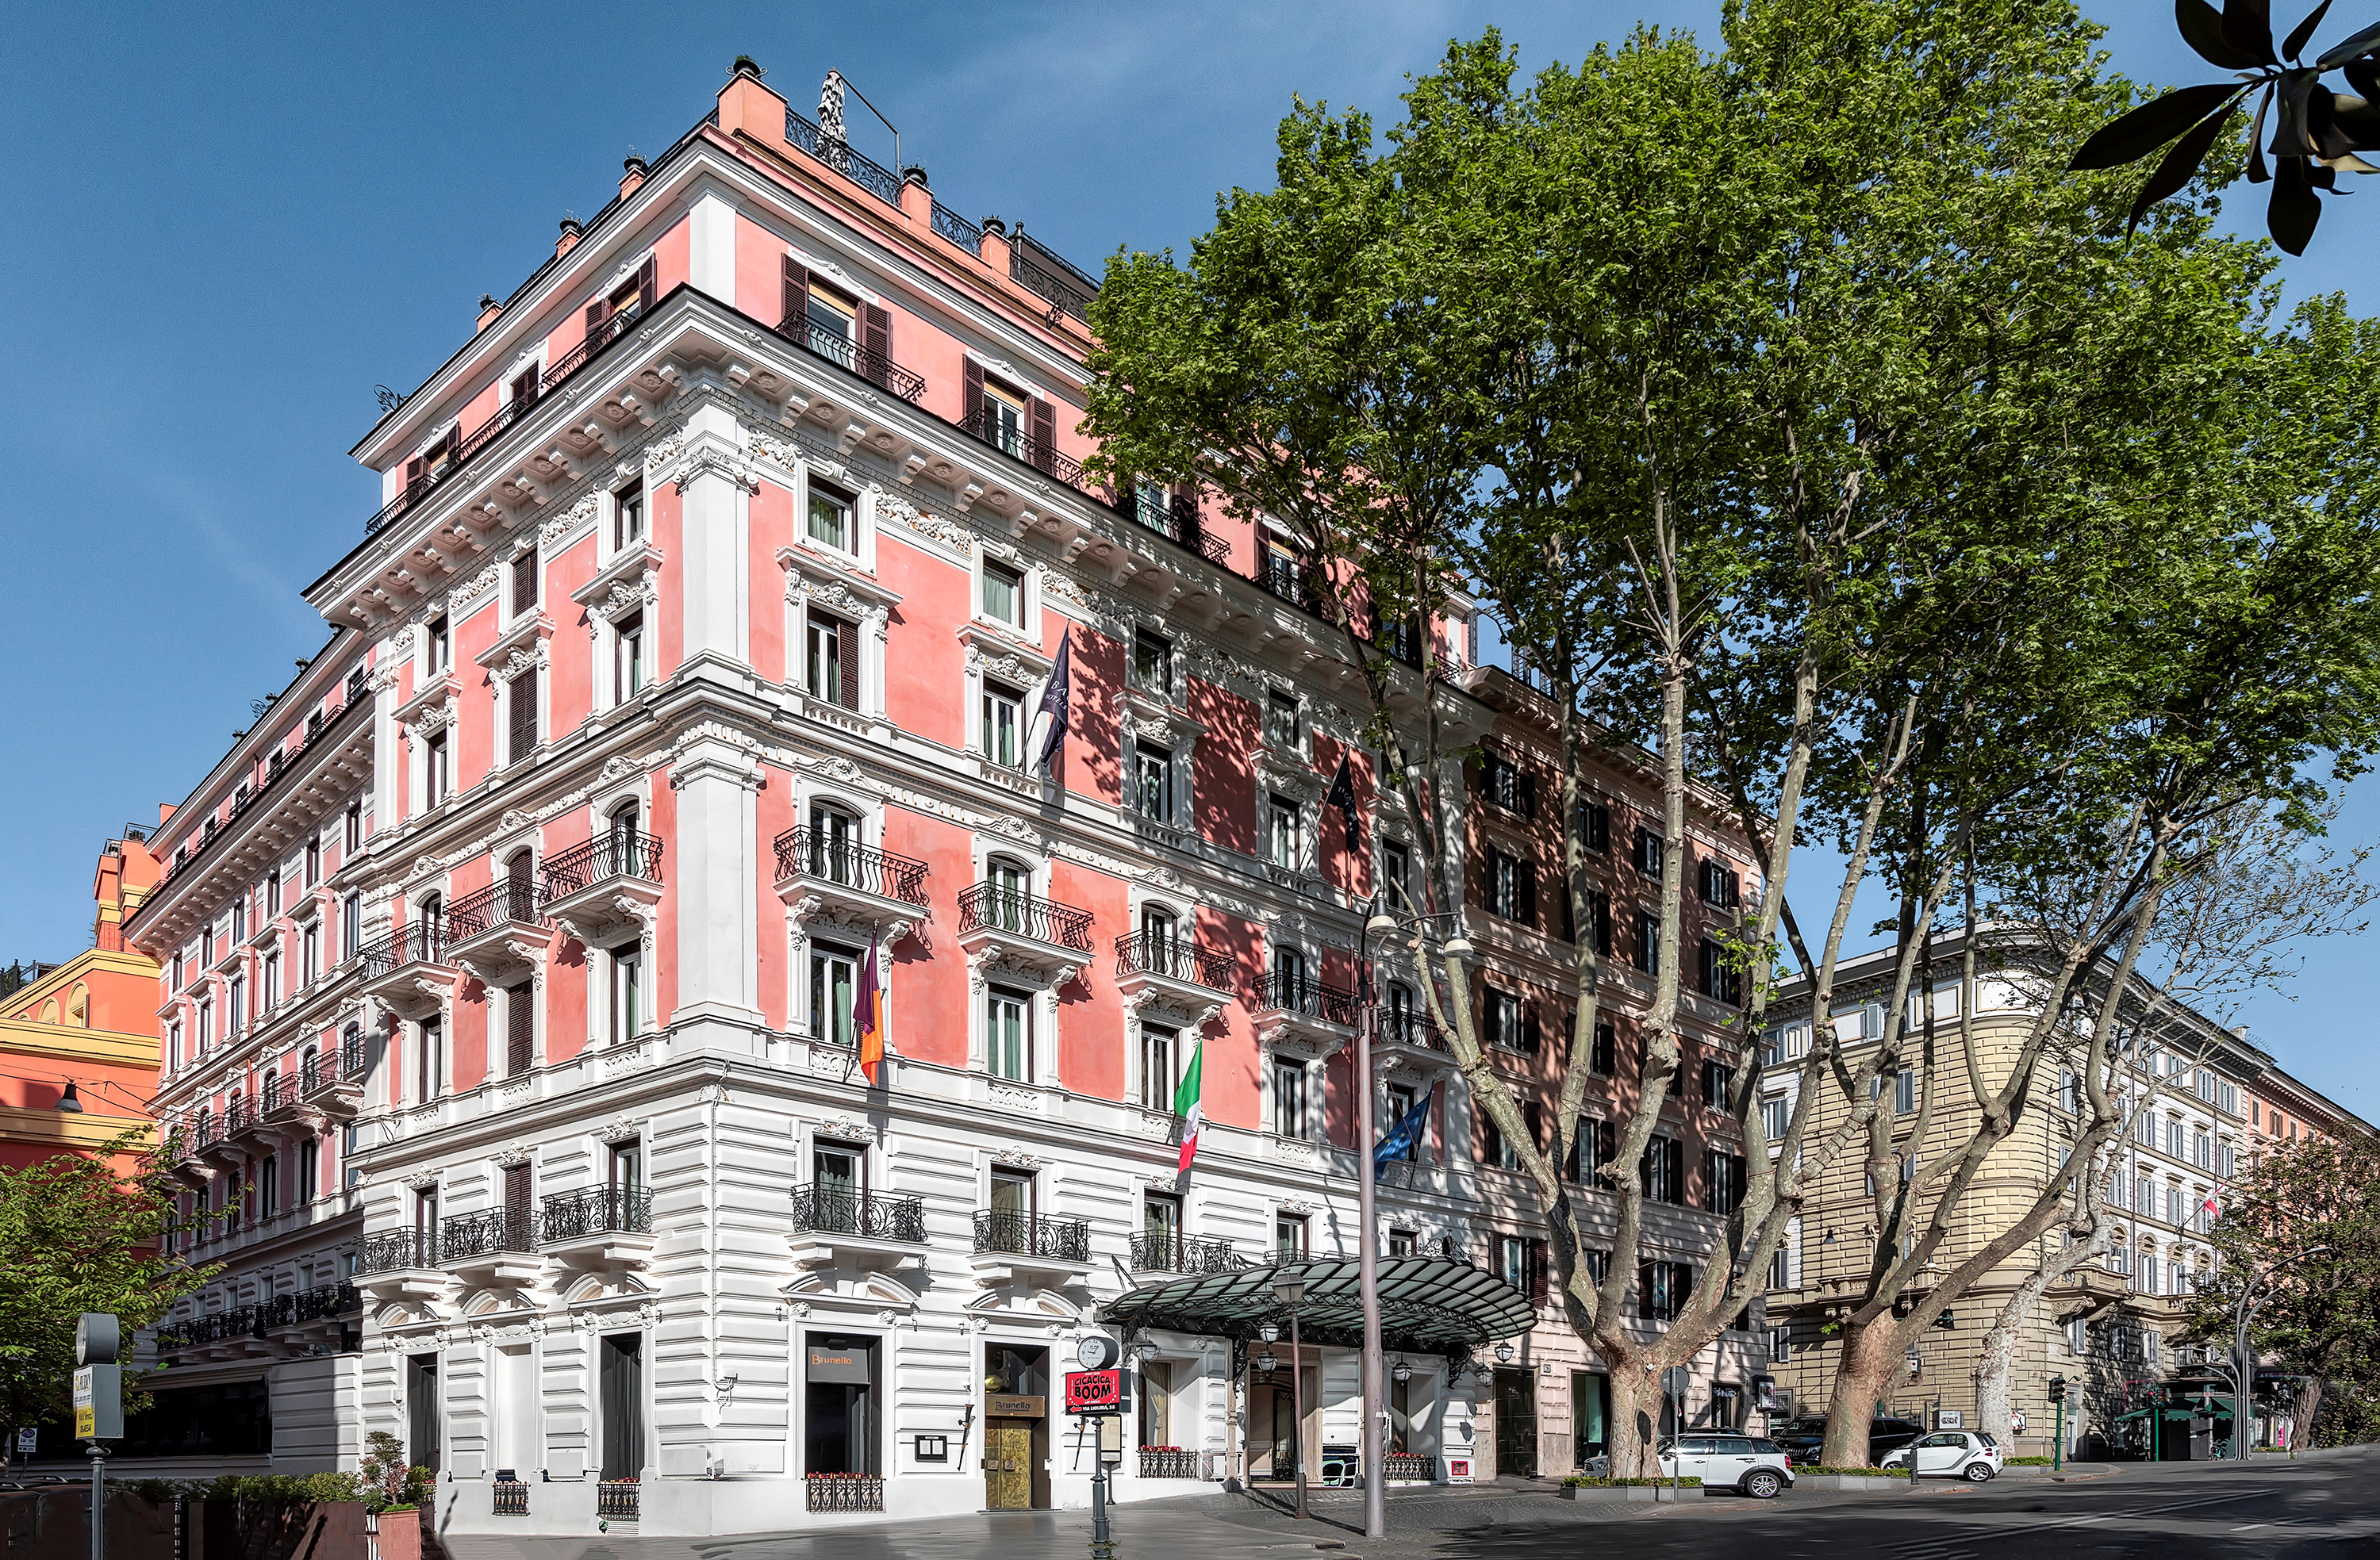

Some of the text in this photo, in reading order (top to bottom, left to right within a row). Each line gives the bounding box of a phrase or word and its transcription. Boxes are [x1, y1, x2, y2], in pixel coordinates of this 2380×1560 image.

[1044, 693, 1068, 710] HOTELS
[812, 1354, 852, 1365] Brunello
[1074, 1375, 1111, 1386] CICACICA
[1074, 1384, 1111, 1400] BOOM
[995, 1401, 1031, 1412] Brunello
